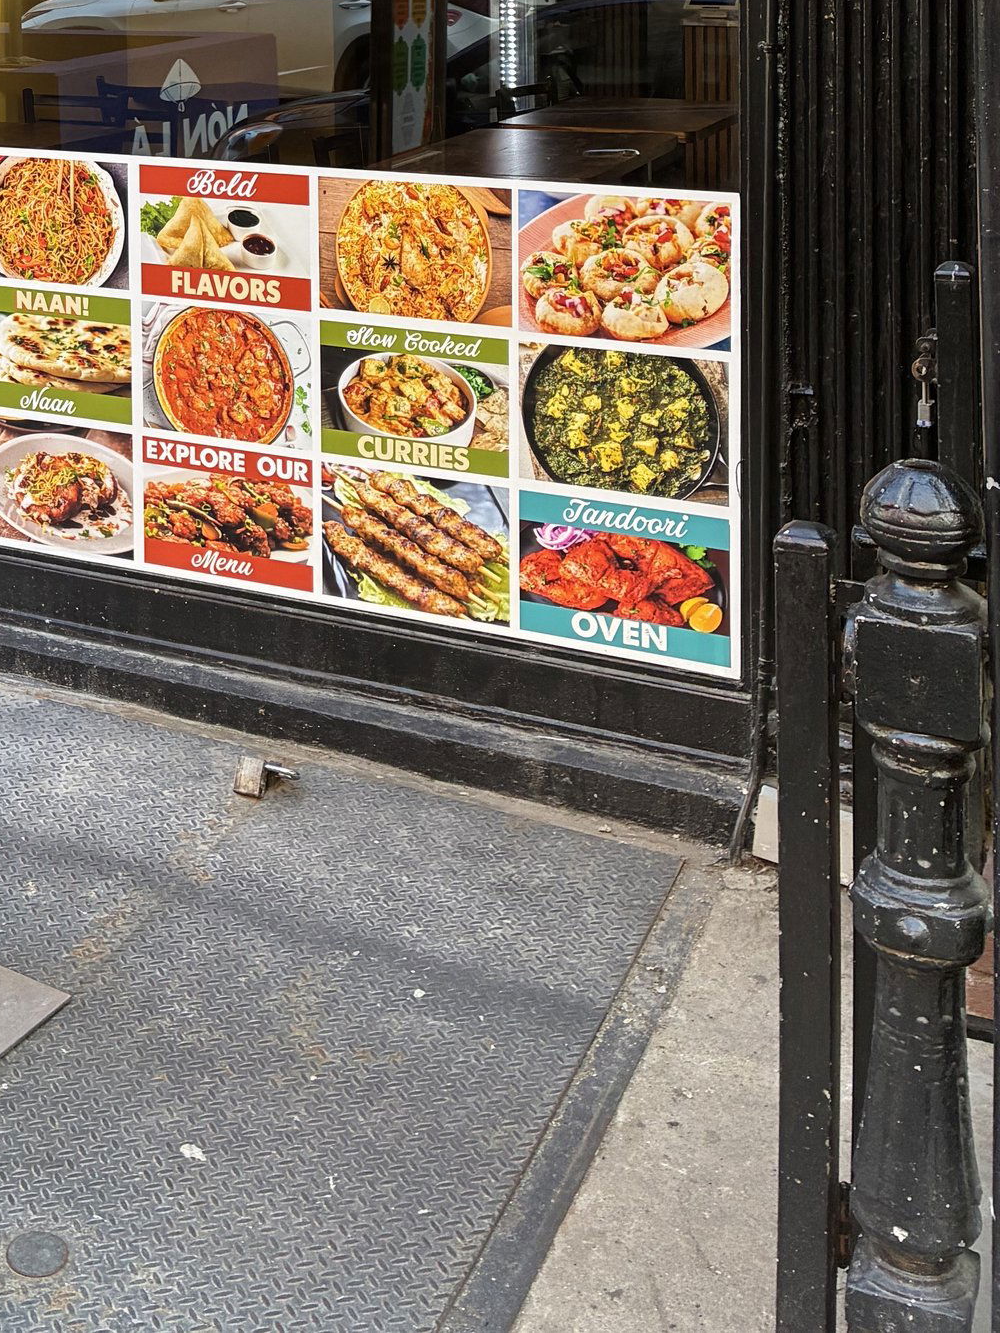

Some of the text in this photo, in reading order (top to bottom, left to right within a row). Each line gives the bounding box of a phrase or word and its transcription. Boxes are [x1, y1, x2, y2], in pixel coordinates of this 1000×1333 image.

[186, 169, 257, 199] Bold
[171, 270, 282, 304] FLAVORS
[16, 290, 89, 317] NAAN!
[346, 328, 482, 359] Slow Cooked
[20, 390, 77, 416] Naan
[145, 440, 309, 483] EXPLORE OUR
[357, 434, 470, 472] CURRIES
[562, 499, 689, 539] Tandoori
[191, 549, 254, 577] Menu
[571, 611, 669, 652] OVEN
